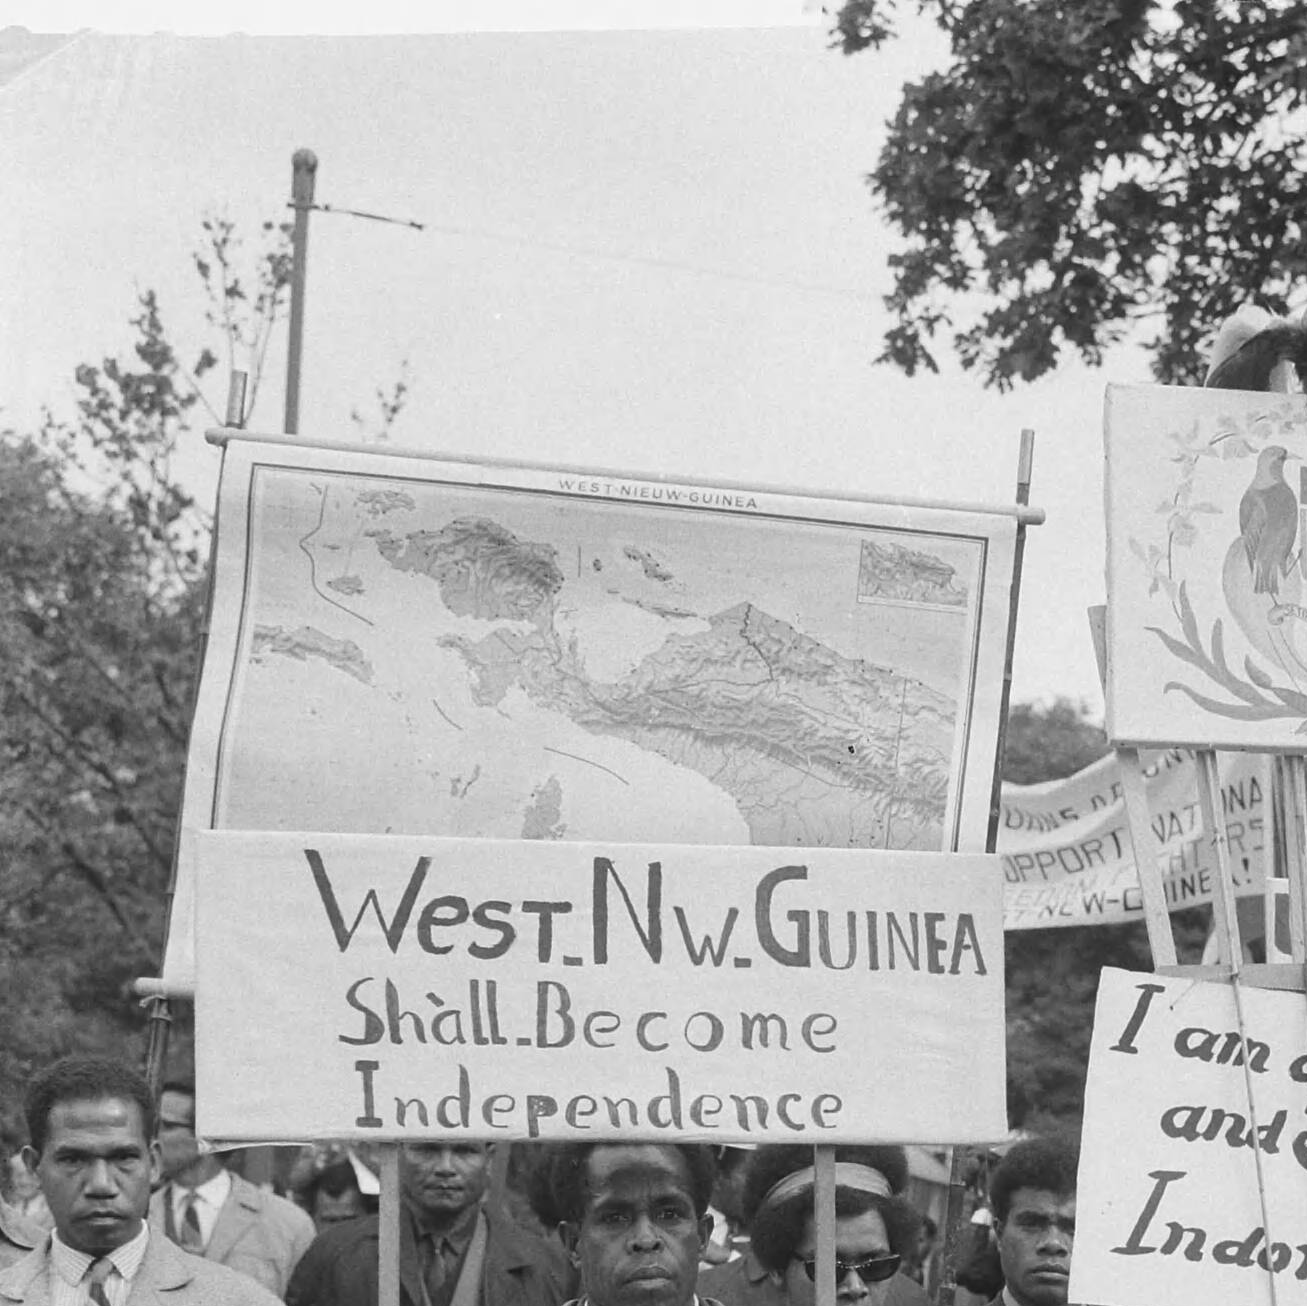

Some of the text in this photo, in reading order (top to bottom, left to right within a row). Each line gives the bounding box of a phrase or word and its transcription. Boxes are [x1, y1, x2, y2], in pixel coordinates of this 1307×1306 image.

[1003, 827, 1126, 884] UPPORT
[1110, 983, 1166, 1054] I
[1174, 1026, 1270, 1074] am
[355, 1060, 845, 1139] Independence
[1160, 1101, 1288, 1155] and
